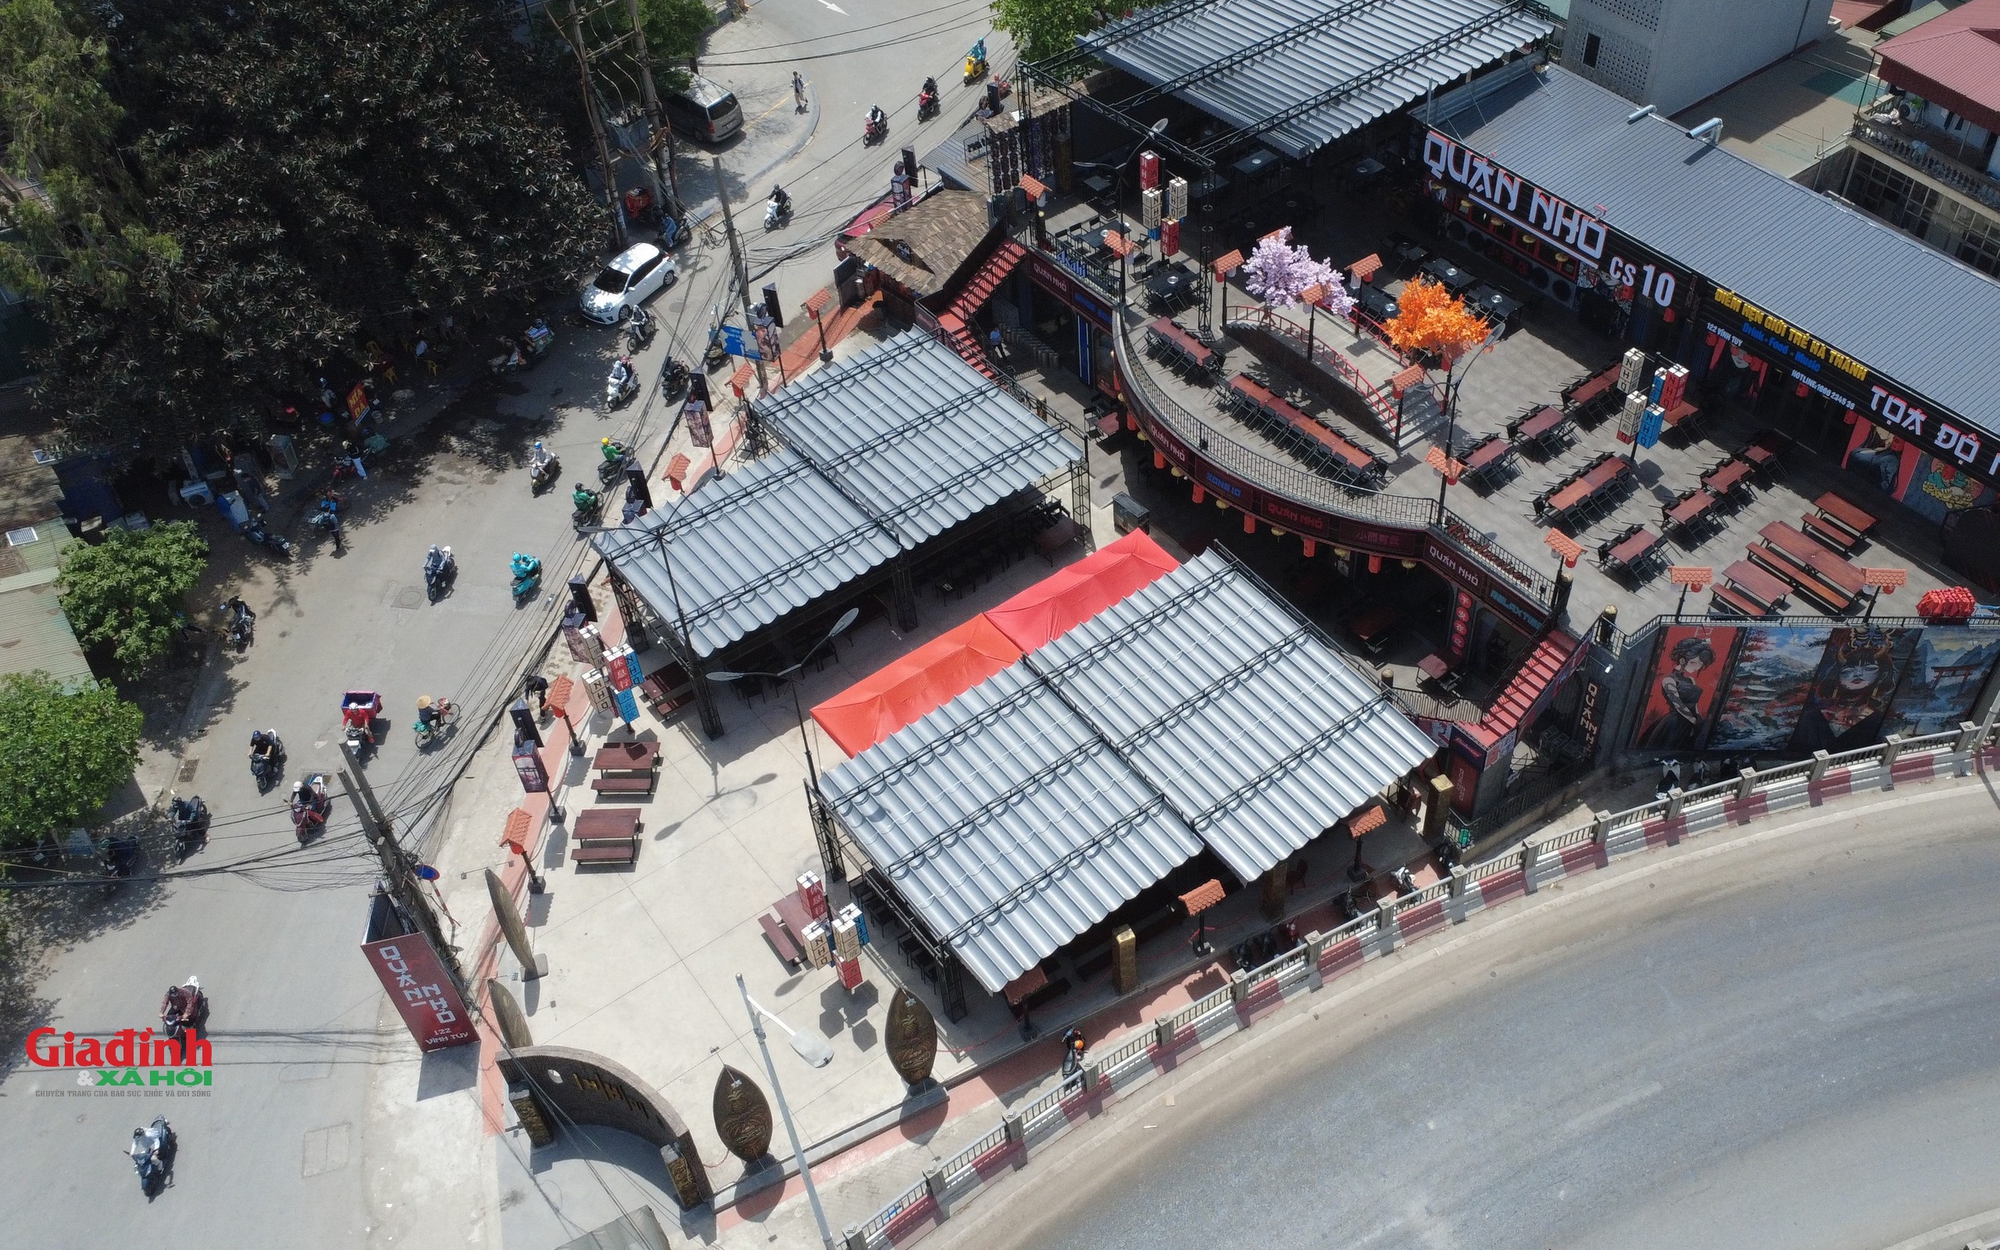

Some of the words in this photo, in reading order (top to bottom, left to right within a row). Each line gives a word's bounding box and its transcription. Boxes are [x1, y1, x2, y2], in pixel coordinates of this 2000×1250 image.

[1423, 130, 1523, 212] QUÁN
[1609, 256, 1637, 287] CS
[1642, 264, 1676, 307] 10
[1706, 322, 1718, 333] 122
[1741, 303, 1764, 325] HẸN
[1742, 322, 1765, 342] Drink
[1768, 336, 1790, 355] Food
[1794, 350, 1821, 373] Music
[1934, 422, 1981, 465] ĐỘ
[1429, 545, 1456, 570] QUÁN
[1458, 566, 1479, 586] NHỎ
[379, 945, 424, 1001] QUÁN
[421, 983, 457, 1024] NHỎ
[434, 1027, 452, 1036] 122
